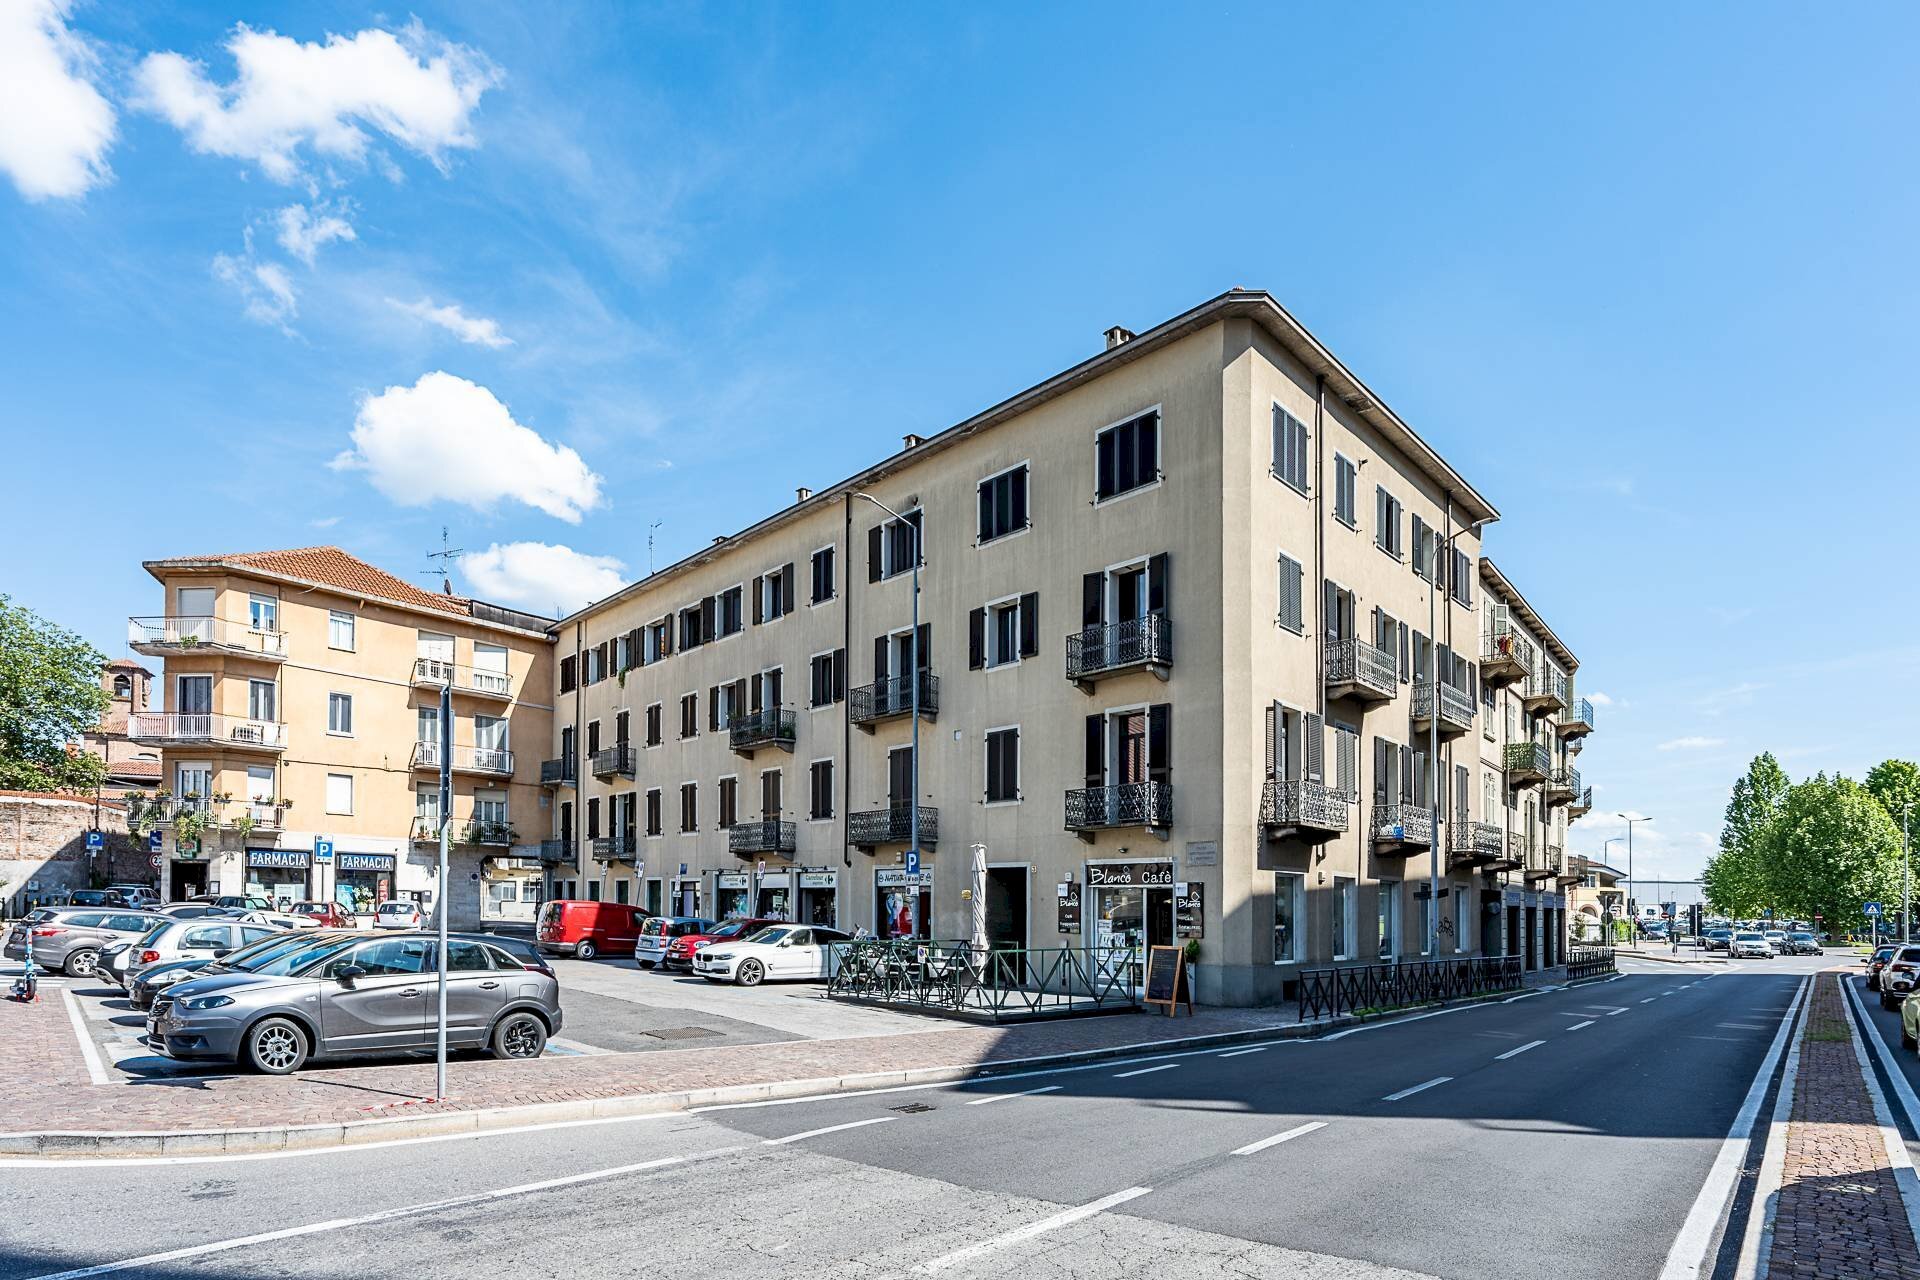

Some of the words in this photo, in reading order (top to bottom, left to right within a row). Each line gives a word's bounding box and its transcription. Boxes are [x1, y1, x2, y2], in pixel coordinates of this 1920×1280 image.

[89, 833, 100, 845] P
[319, 843, 329, 856] P
[251, 852, 307, 866] FARMACIA
[341, 855, 391, 870] FARMACIA
[908, 853, 917, 872] P
[1090, 868, 1132, 885] Blanco
[1141, 870, 1172, 884] Cafè
